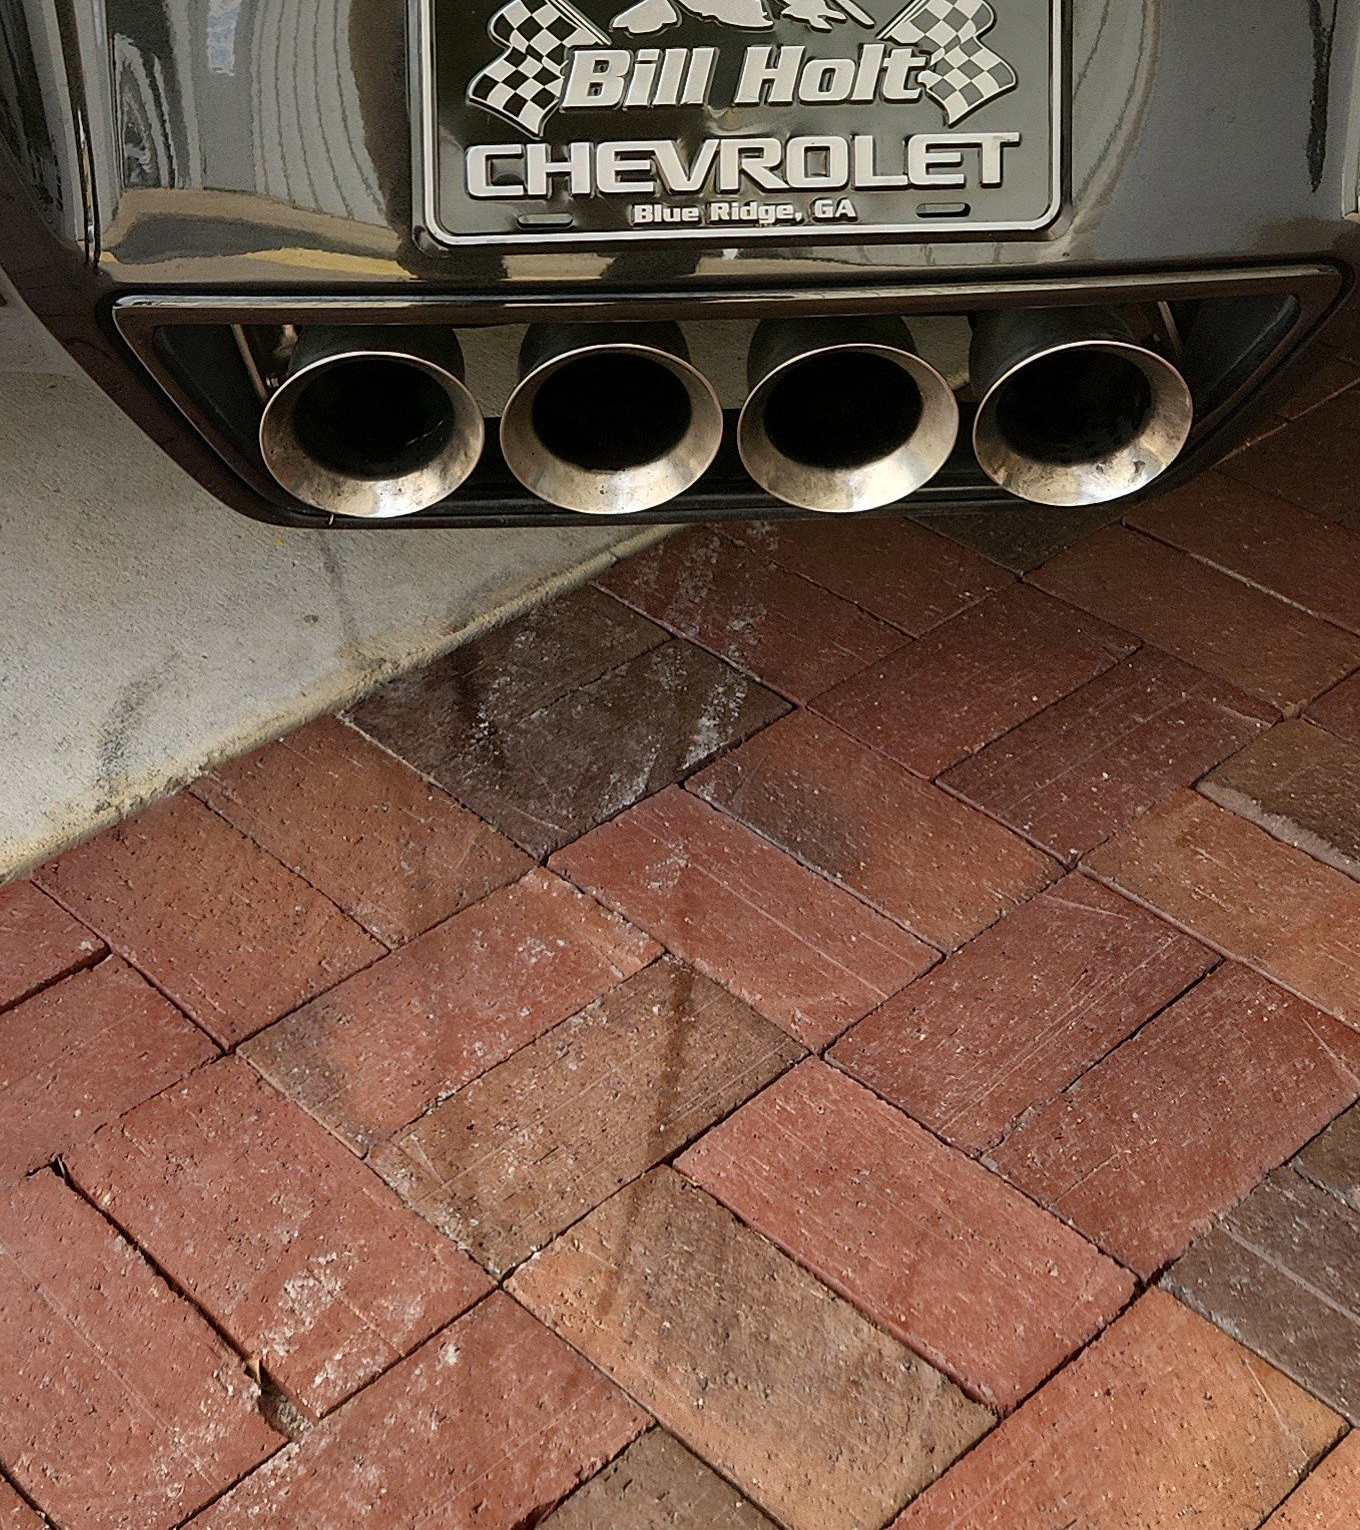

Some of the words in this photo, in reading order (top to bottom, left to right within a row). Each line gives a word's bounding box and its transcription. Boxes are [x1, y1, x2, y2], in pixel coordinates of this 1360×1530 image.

[562, 46, 720, 110] Bill
[735, 42, 930, 105] Holt
[465, 131, 1022, 199] CHEVROLET
[632, 203, 701, 225] Blue
[709, 201, 803, 224] Ridge,
[813, 198, 858, 219] GA
